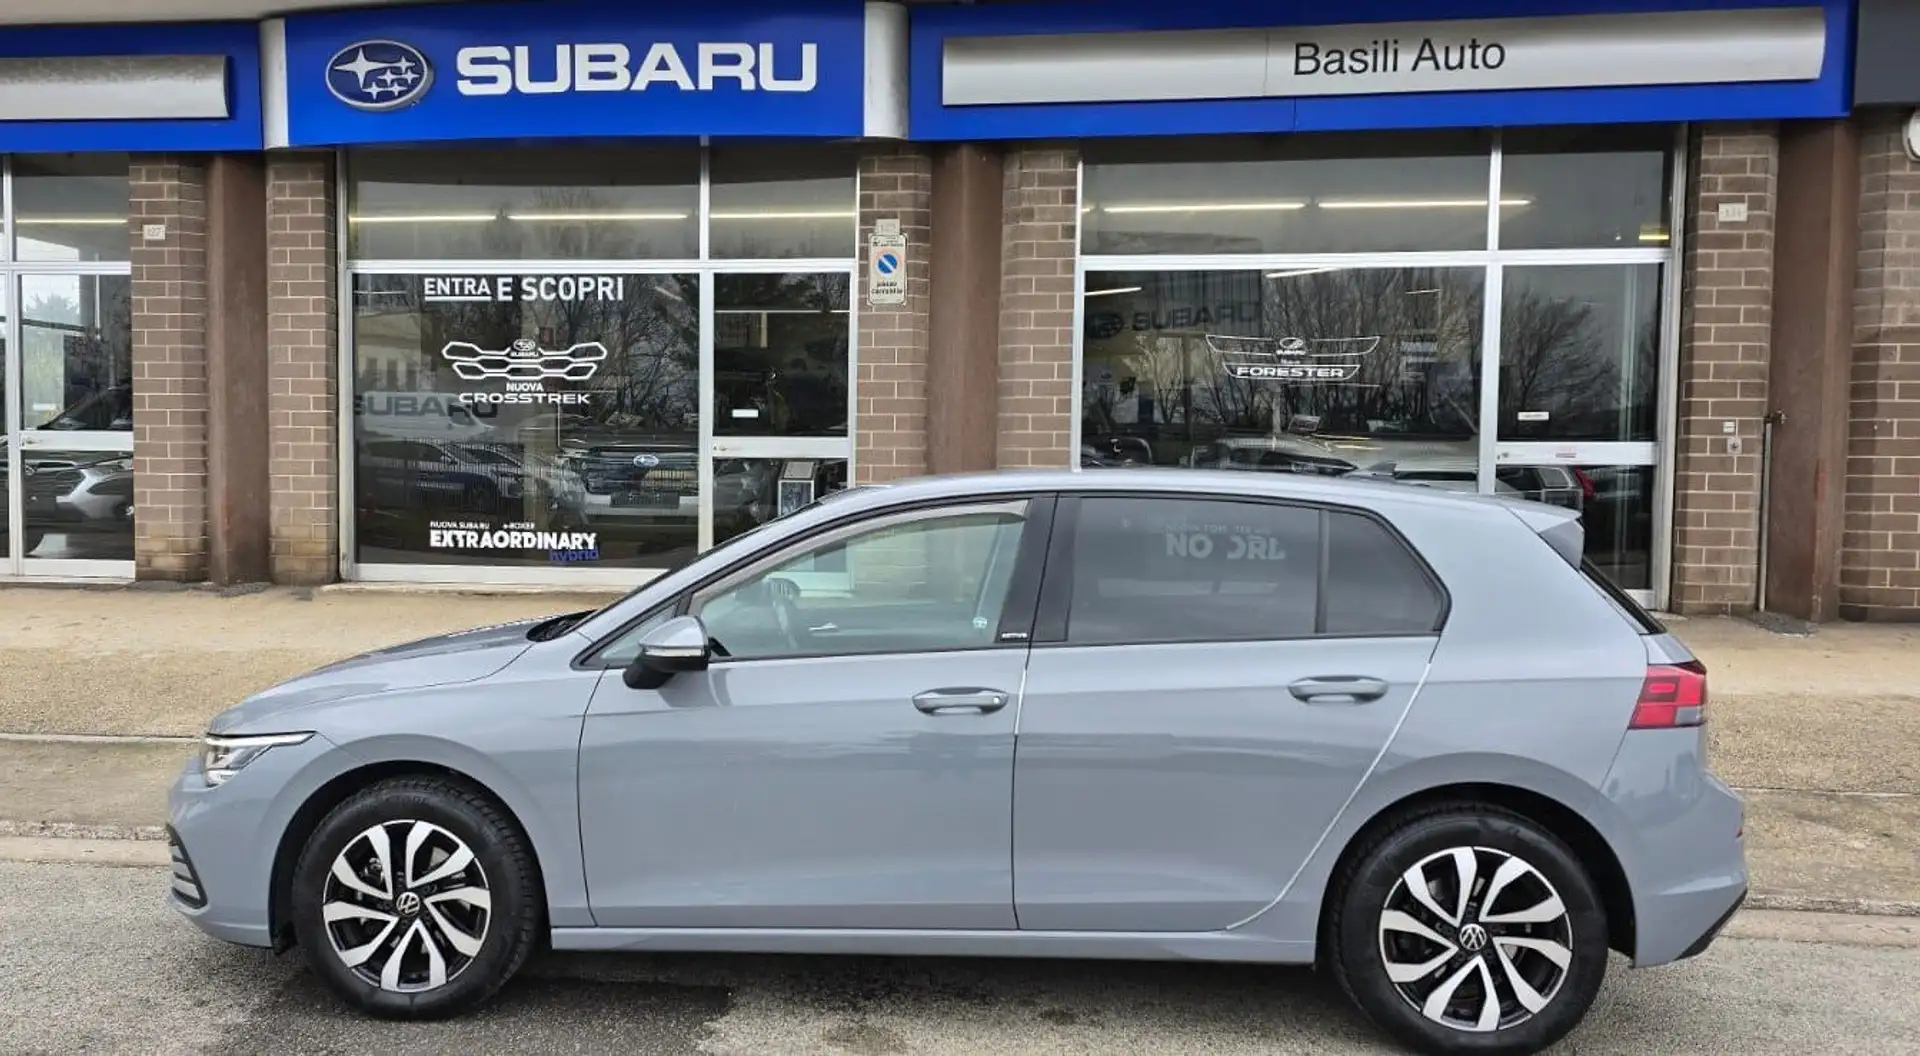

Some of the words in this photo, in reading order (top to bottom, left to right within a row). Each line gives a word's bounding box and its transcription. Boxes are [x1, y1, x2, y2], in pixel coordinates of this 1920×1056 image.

[1293, 39, 1399, 76] Basili
[1411, 37, 1506, 72] Auto
[455, 42, 818, 96] SUBARU
[424, 277, 492, 296] ENTRA
[497, 276, 513, 301] E
[520, 276, 624, 301] SCOPRI
[1236, 366, 1344, 378] FORESTER
[506, 383, 544, 392] NUOVA
[459, 392, 590, 405] CROSSTREK
[429, 521, 458, 529] NUOVA
[429, 529, 597, 550] EXTRAORDINARY
